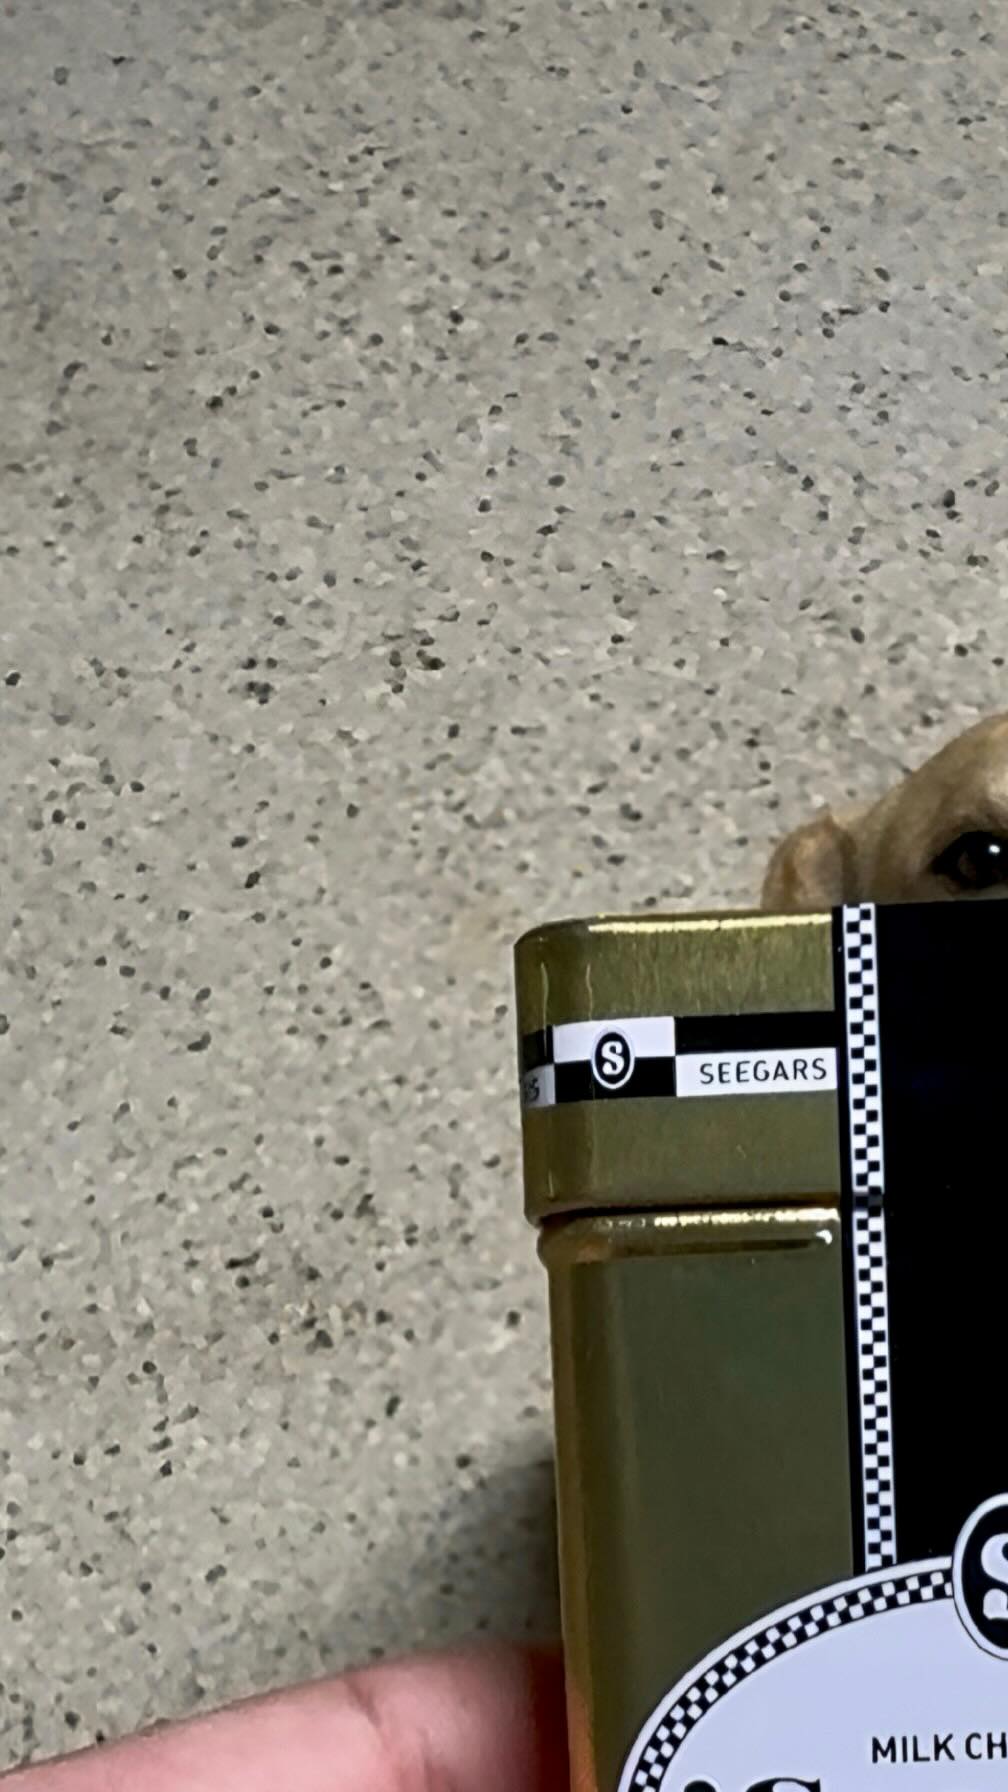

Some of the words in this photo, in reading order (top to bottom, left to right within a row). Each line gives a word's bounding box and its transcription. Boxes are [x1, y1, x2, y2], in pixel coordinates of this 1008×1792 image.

[601, 1040, 623, 1077] S
[700, 1058, 827, 1085] SEEGARS
[871, 1732, 957, 1764] MILK
